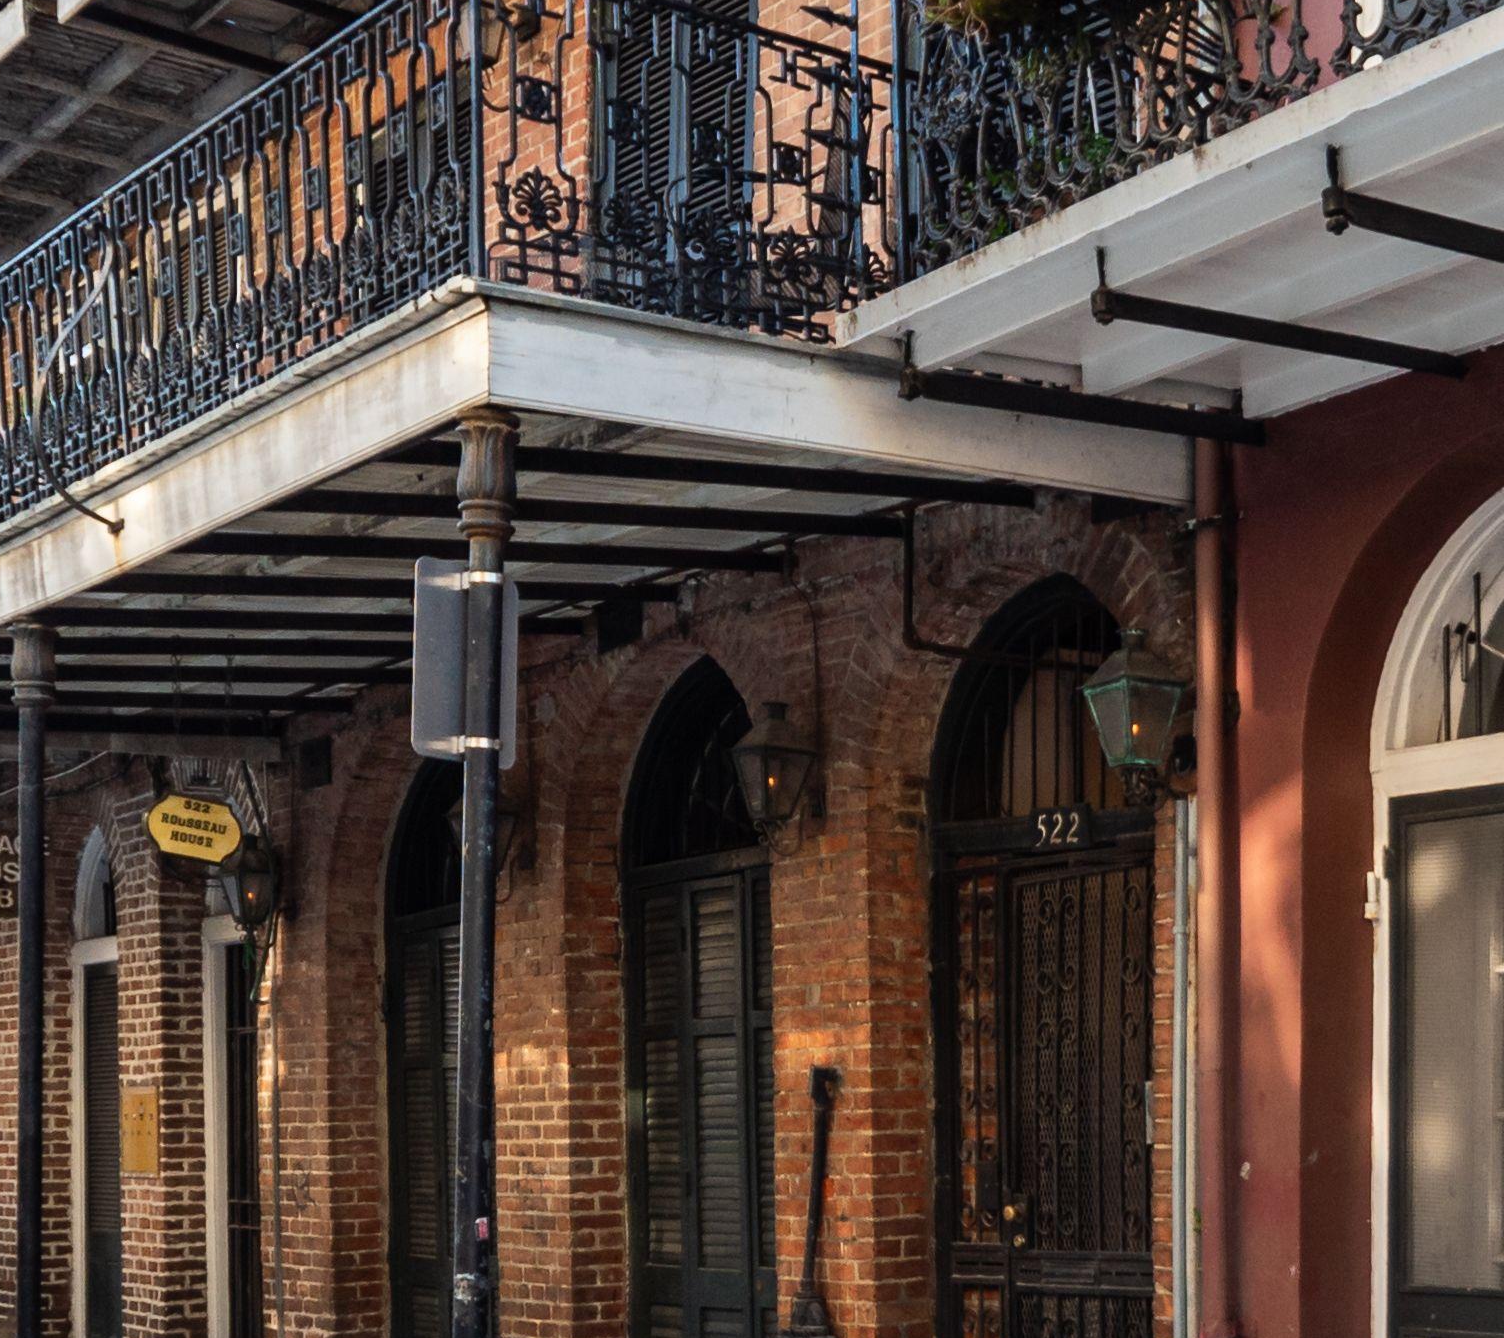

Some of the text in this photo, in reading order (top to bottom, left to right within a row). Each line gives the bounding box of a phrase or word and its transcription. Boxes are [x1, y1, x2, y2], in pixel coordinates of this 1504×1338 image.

[183, 799, 211, 813] 522
[1035, 811, 1081, 848] 522
[170, 830, 214, 848] HOUSE
